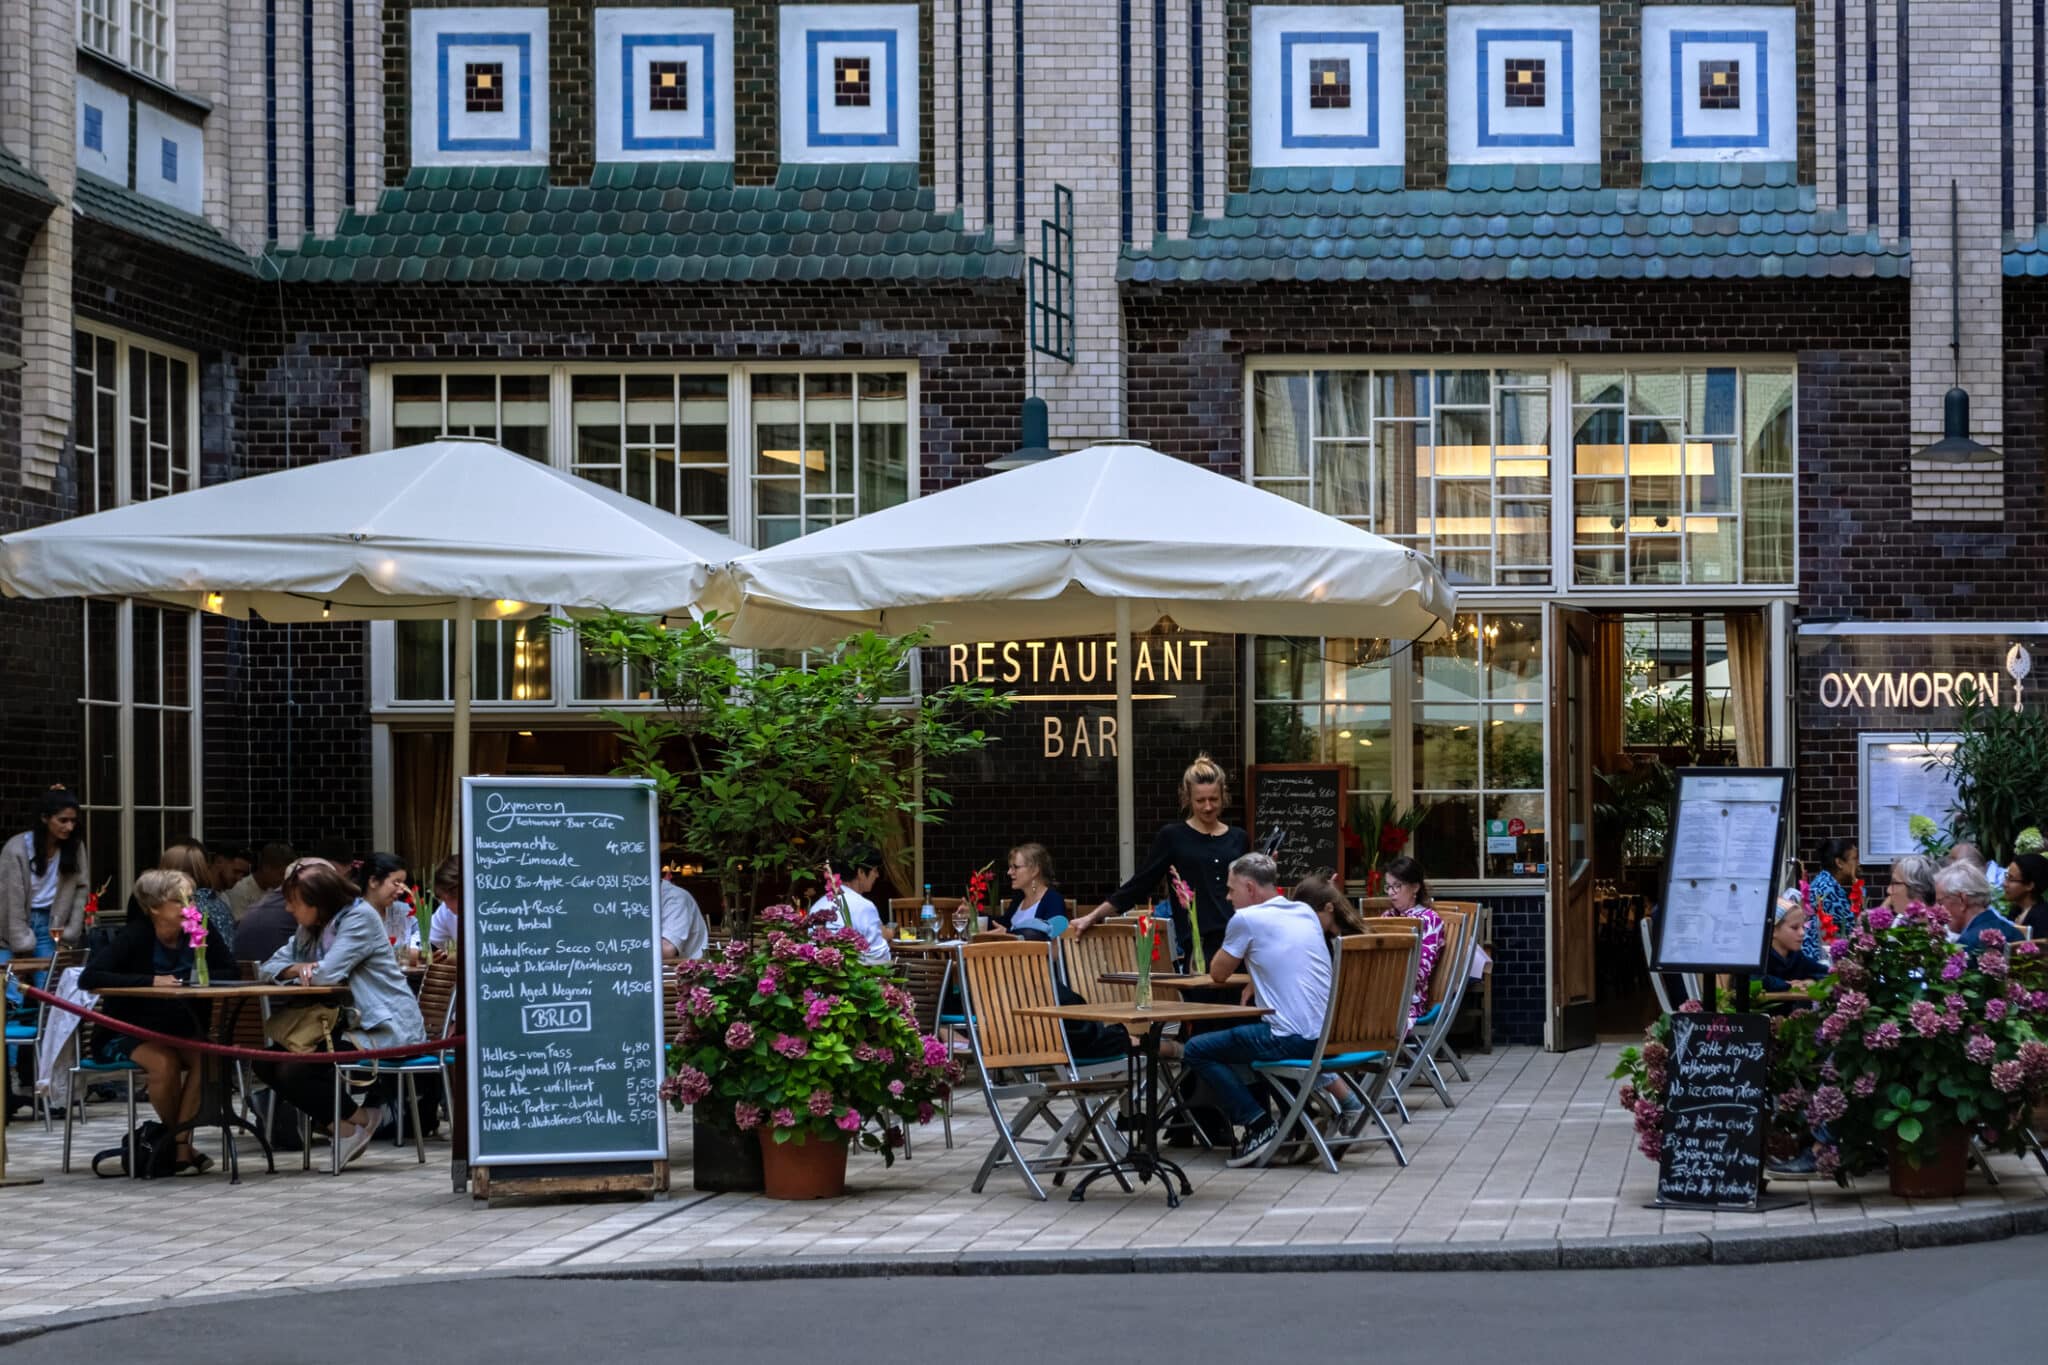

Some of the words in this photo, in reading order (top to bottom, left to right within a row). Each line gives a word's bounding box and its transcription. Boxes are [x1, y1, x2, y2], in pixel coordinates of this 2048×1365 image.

[1820, 672, 1999, 708] OXYMORON
[1044, 716, 1118, 757] BAR
[487, 792, 566, 831] Oxymoron
[475, 873, 510, 889] BRLO
[556, 940, 590, 953] Secco
[481, 962, 520, 977] Weingut
[480, 983, 514, 1000] Barrel
[520, 982, 547, 1002] Aged
[552, 981, 592, 1000] Negroni
[531, 1008, 582, 1027] BRLO
[1693, 1023, 1744, 1033] BORDEAUX
[482, 1047, 517, 1062] Helles
[622, 1041, 650, 1053] 4,80
[553, 1062, 571, 1076] IPA
[624, 1058, 651, 1072] 5,80
[482, 1084, 506, 1098] Pale
[510, 1082, 531, 1095] Ale
[627, 1077, 656, 1092] 5,50
[1669, 1080, 1684, 1096] No
[482, 1100, 520, 1117] Baltic
[524, 1096, 560, 1113] Porter
[627, 1093, 656, 1108] 5,70
[482, 1116, 520, 1132] Naked
[629, 1109, 657, 1125] 5,50
